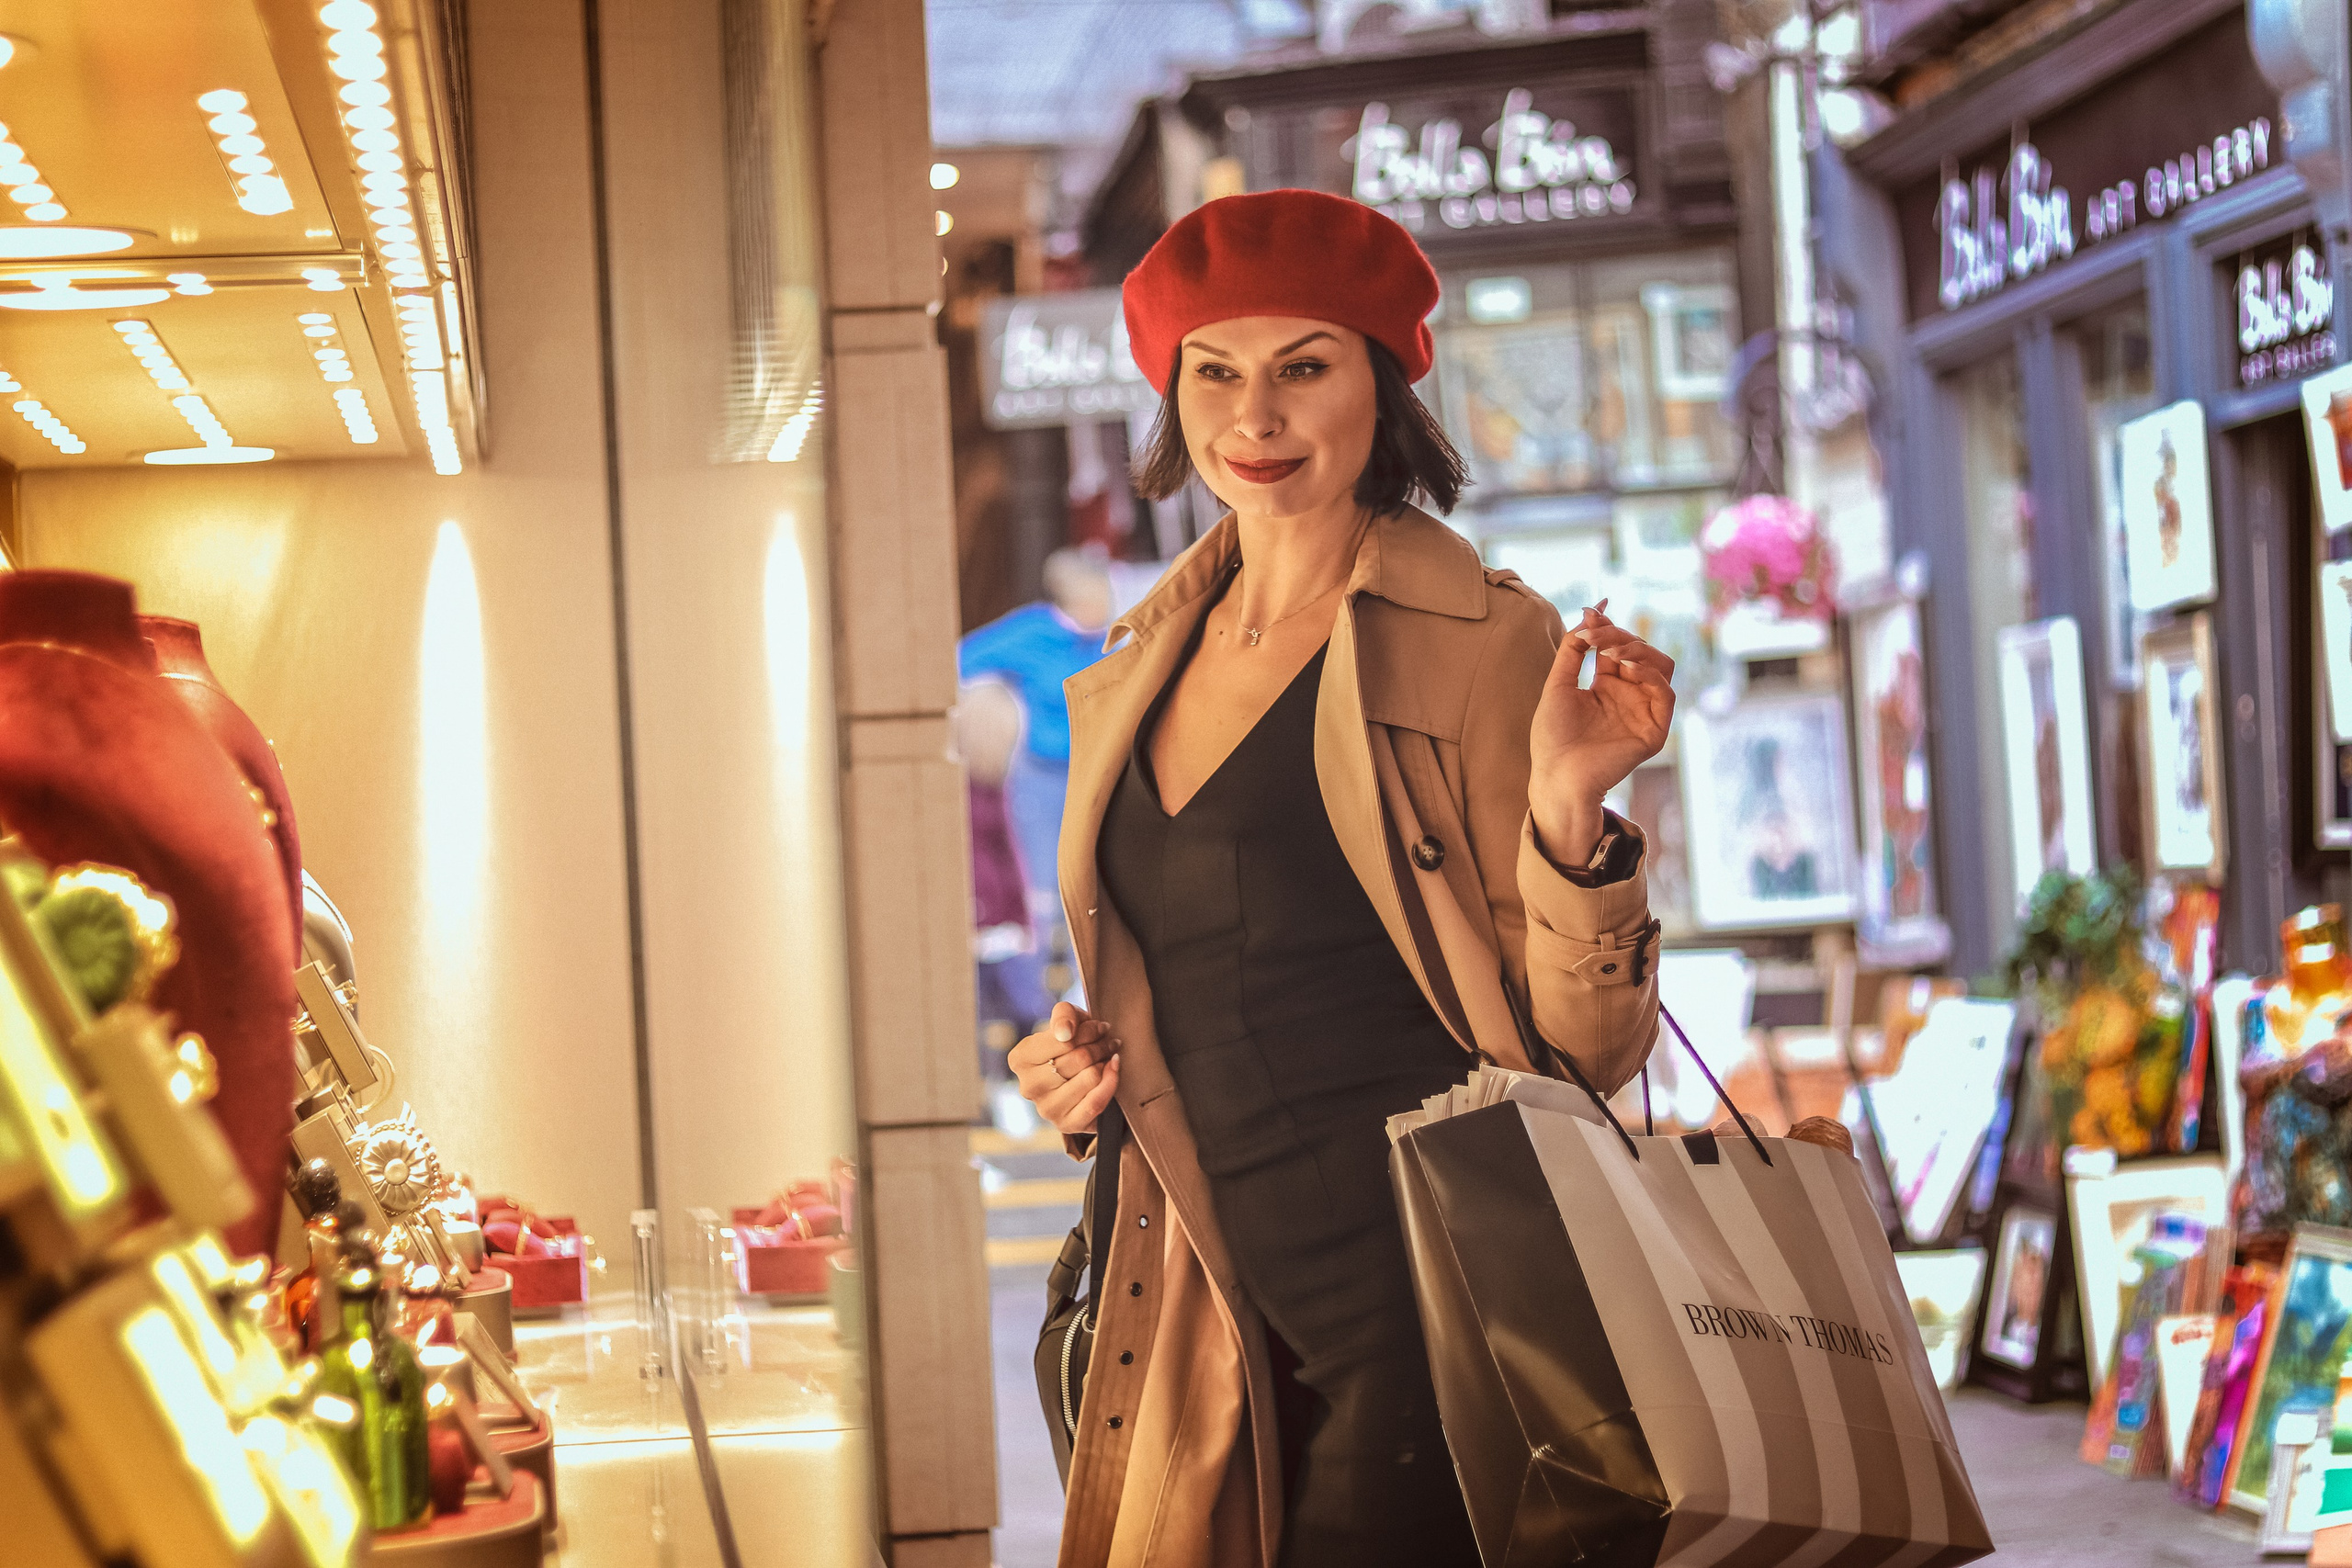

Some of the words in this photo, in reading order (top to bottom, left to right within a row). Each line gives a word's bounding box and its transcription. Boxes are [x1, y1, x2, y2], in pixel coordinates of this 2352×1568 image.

[2086, 179, 2138, 243] ART
[2143, 117, 2270, 218] GALLERY
[1682, 1303, 1792, 1344] BROWN
[1791, 1315, 1894, 1365] THOMAS
